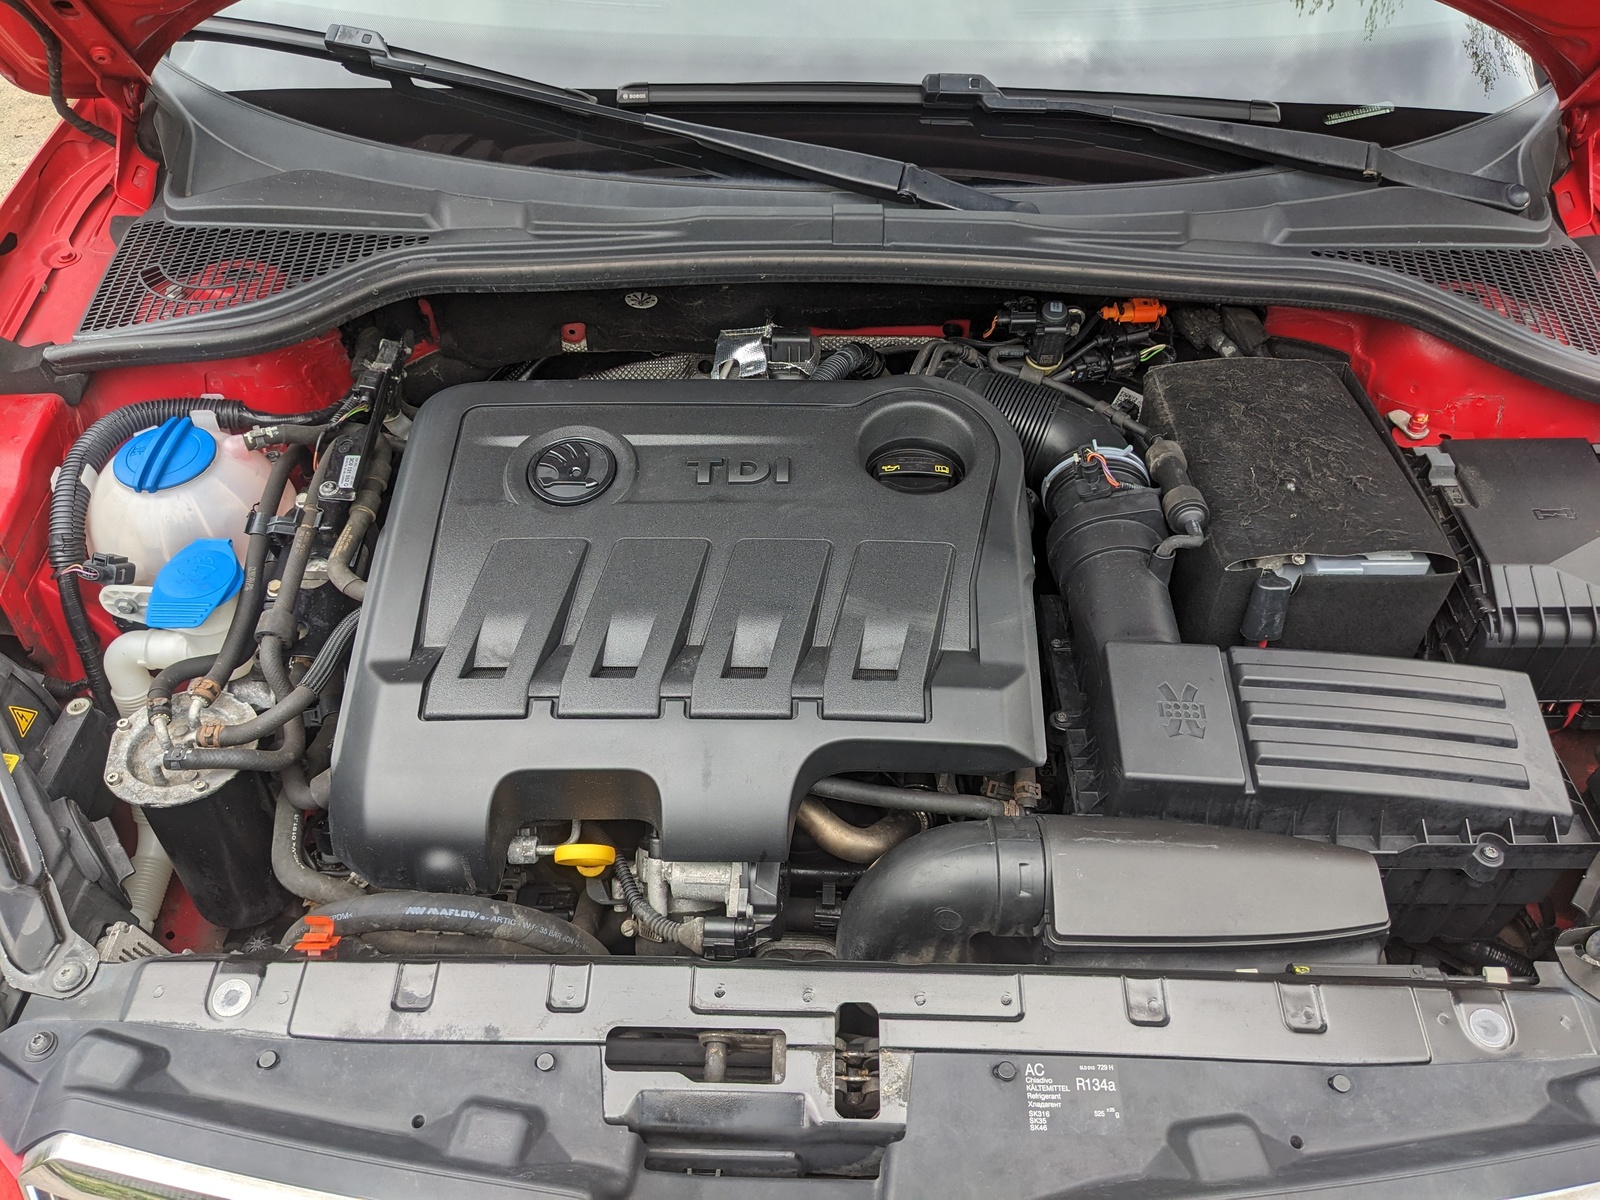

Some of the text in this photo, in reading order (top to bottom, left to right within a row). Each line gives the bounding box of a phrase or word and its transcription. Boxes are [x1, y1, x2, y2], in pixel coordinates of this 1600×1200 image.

[685, 457, 791, 485] TDI
[490, 915, 517, 926] ARTIC
[539, 926, 549, 935] 35
[548, 930, 562, 940] BAR
[1025, 1063, 1045, 1076] AC
[1026, 1084, 1071, 1092] KÄLTEMITTEL
[1075, 1077, 1117, 1092] R134a
[1027, 1092, 1062, 1101] Refrigerant
[1028, 1110, 1051, 1118] SK316
[1093, 1110, 1106, 1118] 525
[1114, 1111, 1120, 1119] g
